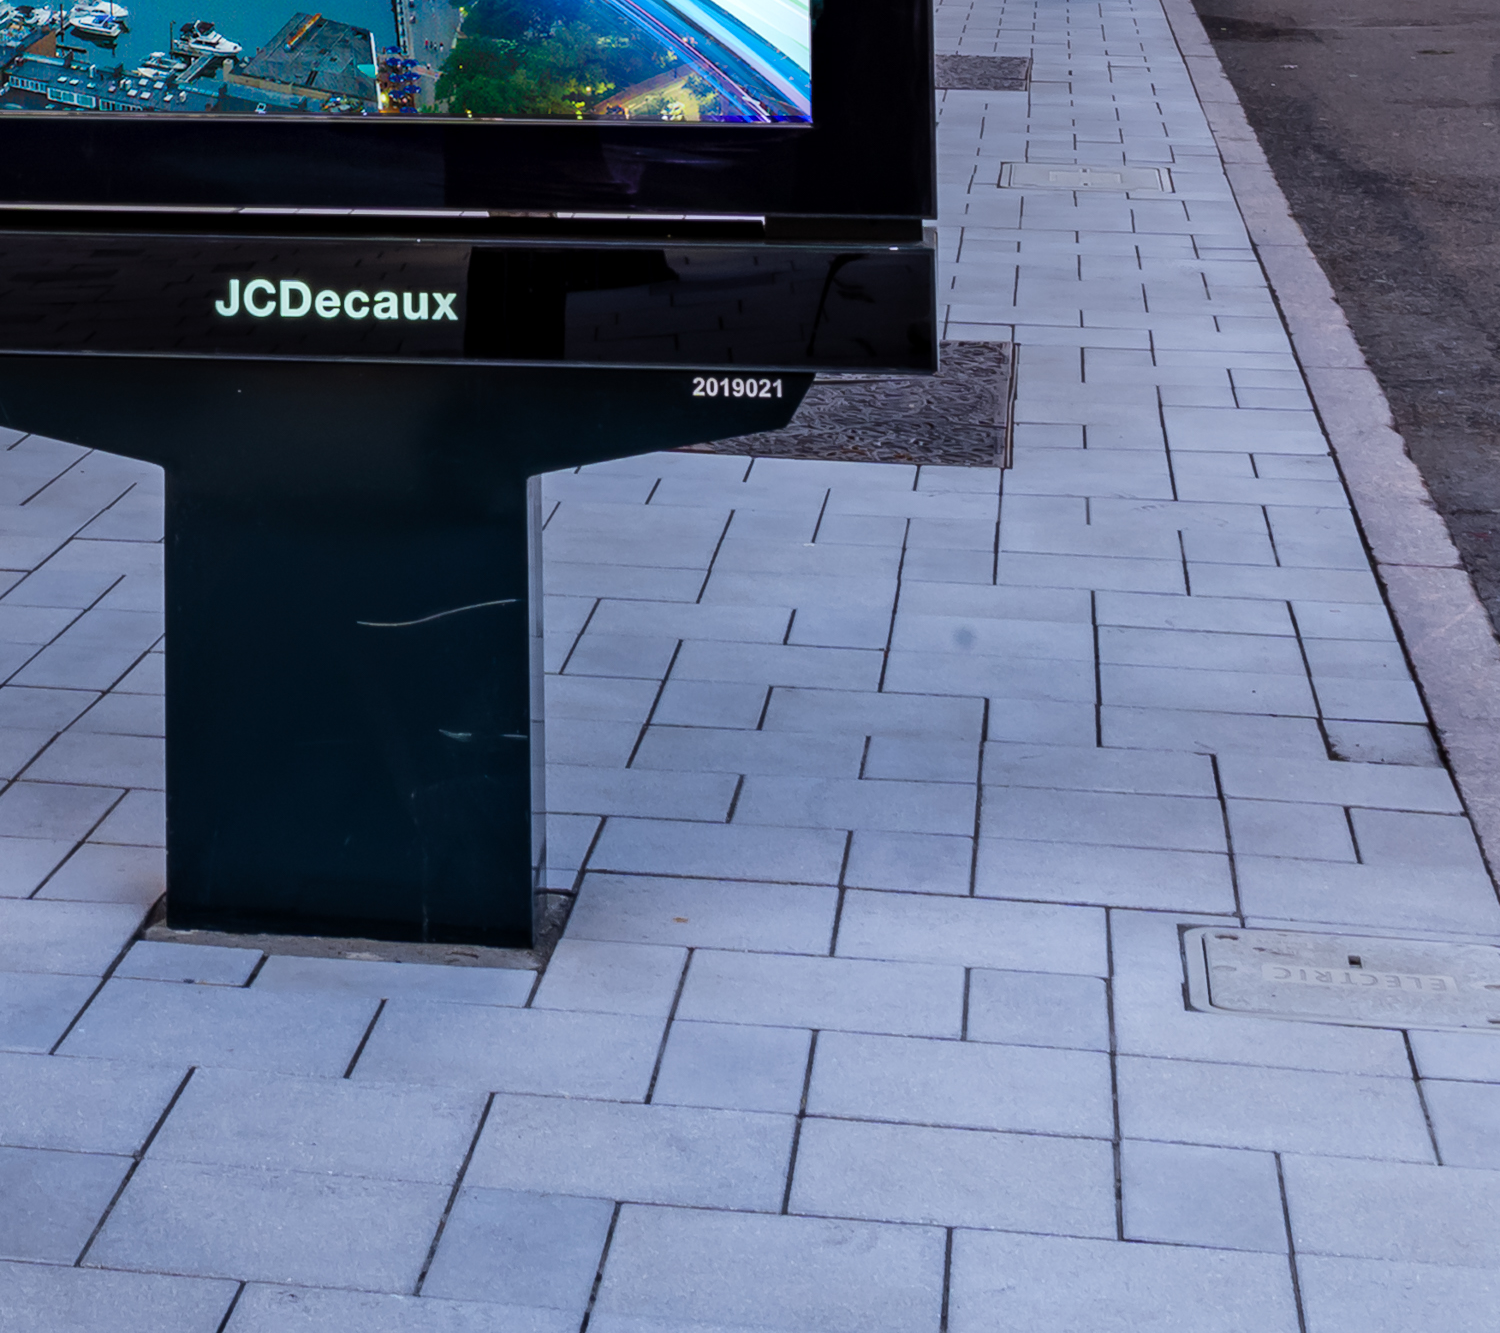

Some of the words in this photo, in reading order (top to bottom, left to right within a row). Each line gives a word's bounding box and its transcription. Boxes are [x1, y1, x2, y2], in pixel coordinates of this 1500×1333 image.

[215, 278, 459, 320] JCDecaux
[692, 377, 783, 398] 2019021
[1272, 965, 1447, 992] ELECTRIC
